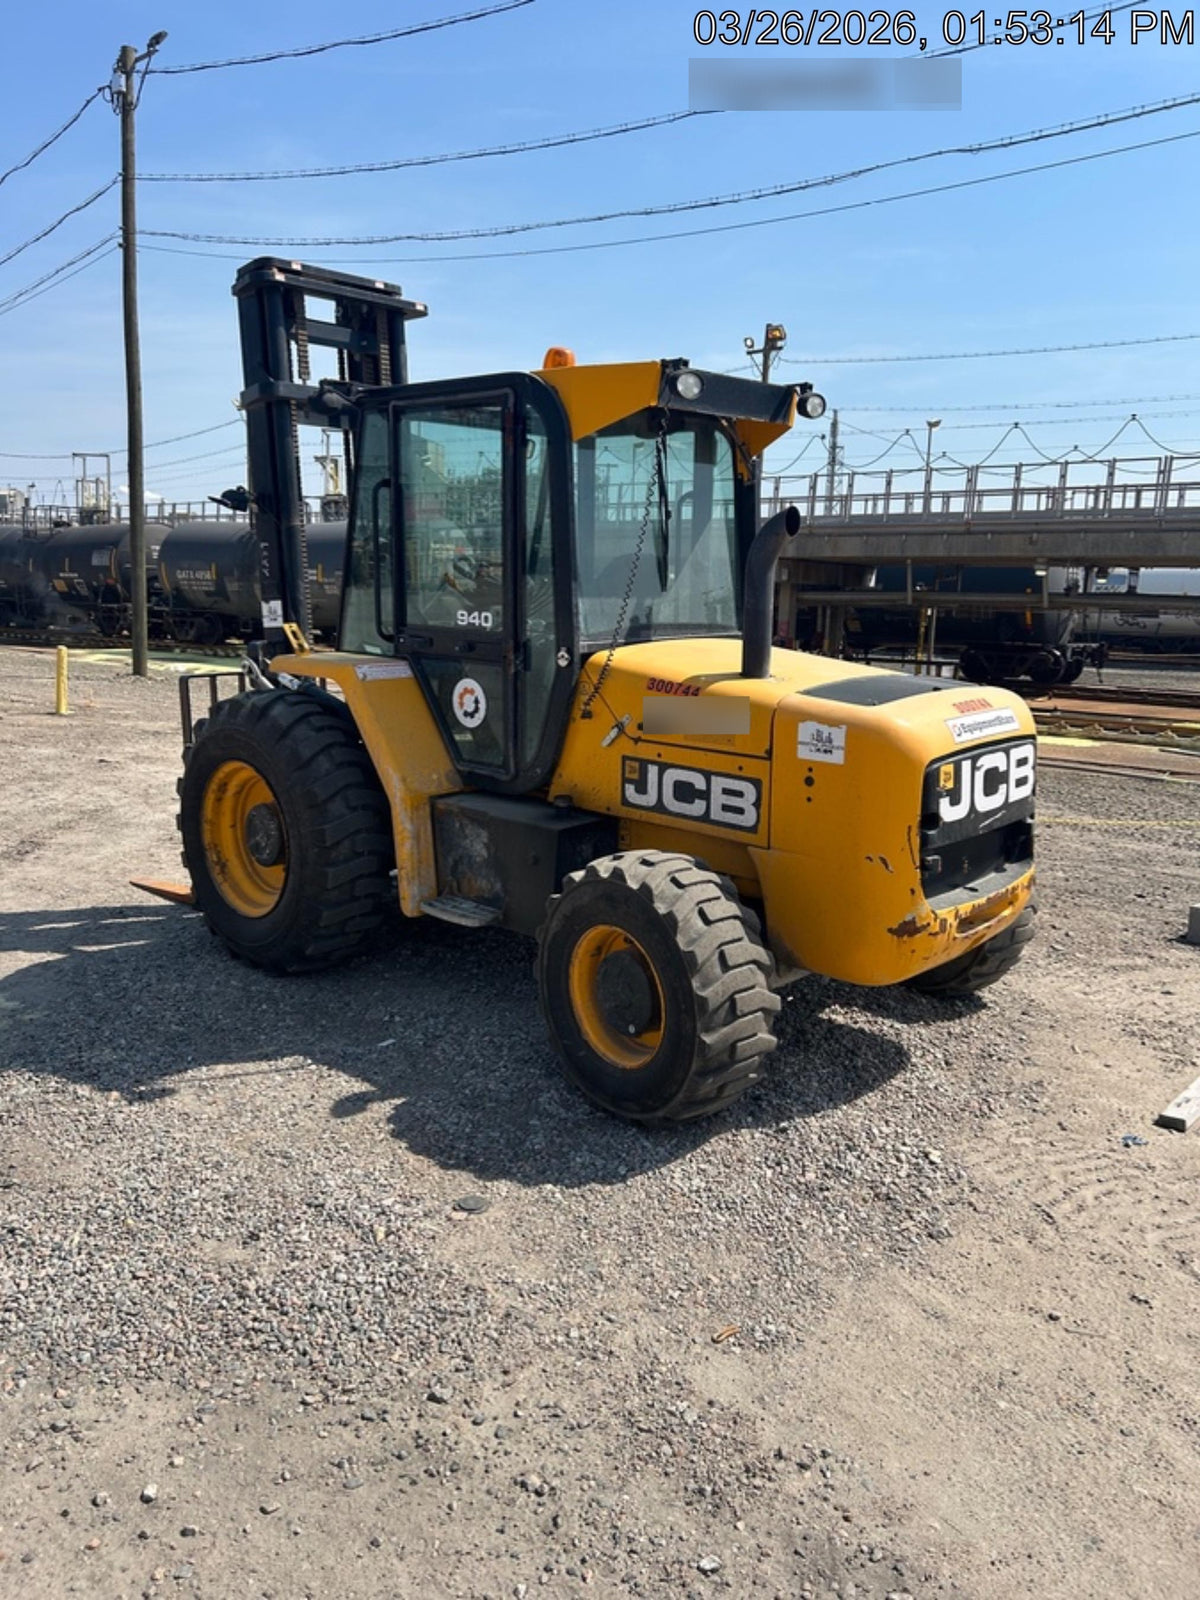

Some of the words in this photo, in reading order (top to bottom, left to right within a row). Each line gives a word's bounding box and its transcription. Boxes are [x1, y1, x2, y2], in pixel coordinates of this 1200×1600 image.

[456, 610, 493, 627] 940
[646, 677, 701, 697] 300744
[624, 764, 758, 828] JCB
[939, 745, 1034, 822] JCB
